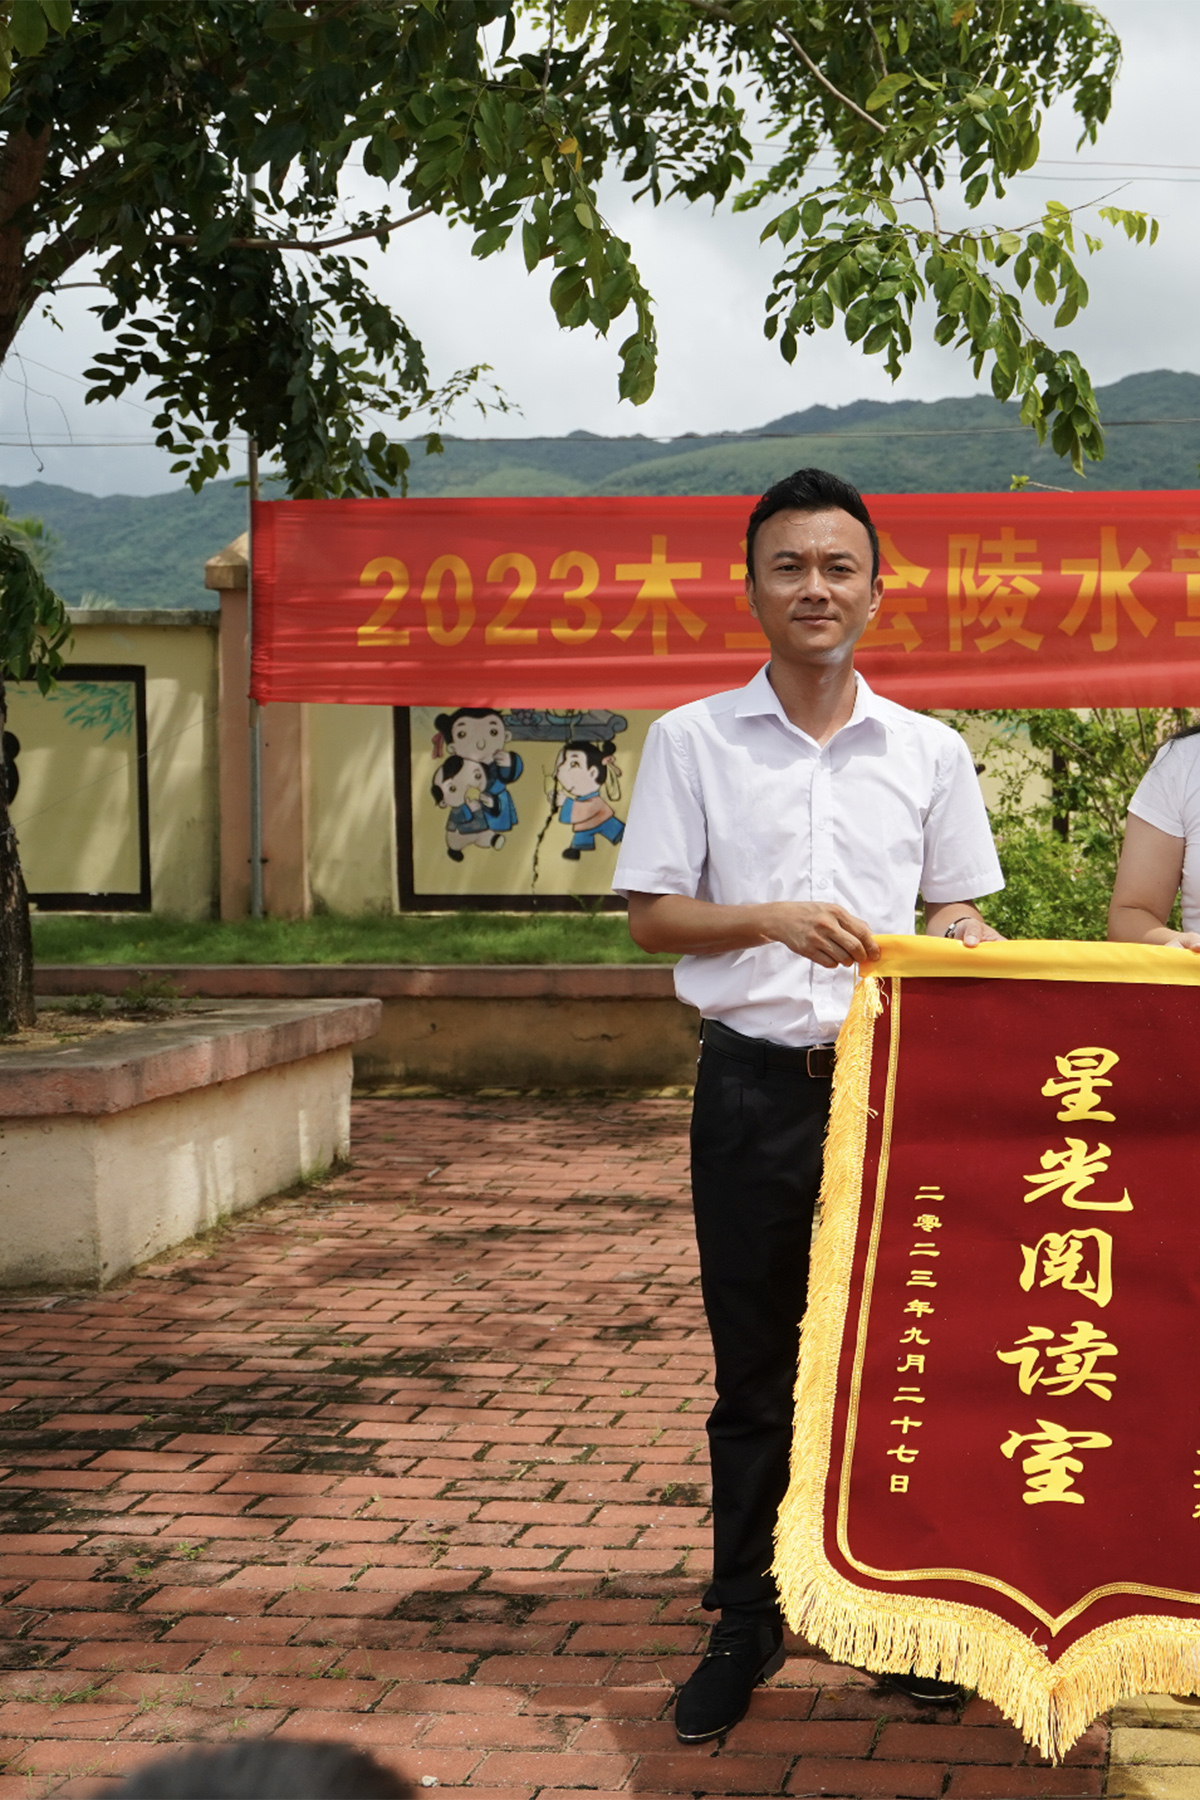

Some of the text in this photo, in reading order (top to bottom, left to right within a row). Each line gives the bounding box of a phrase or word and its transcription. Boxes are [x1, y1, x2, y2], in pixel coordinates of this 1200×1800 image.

[887, 1186, 945, 1493] 二零二三年九月二十七日
[997, 1047, 1134, 1505] 星光阅读室
